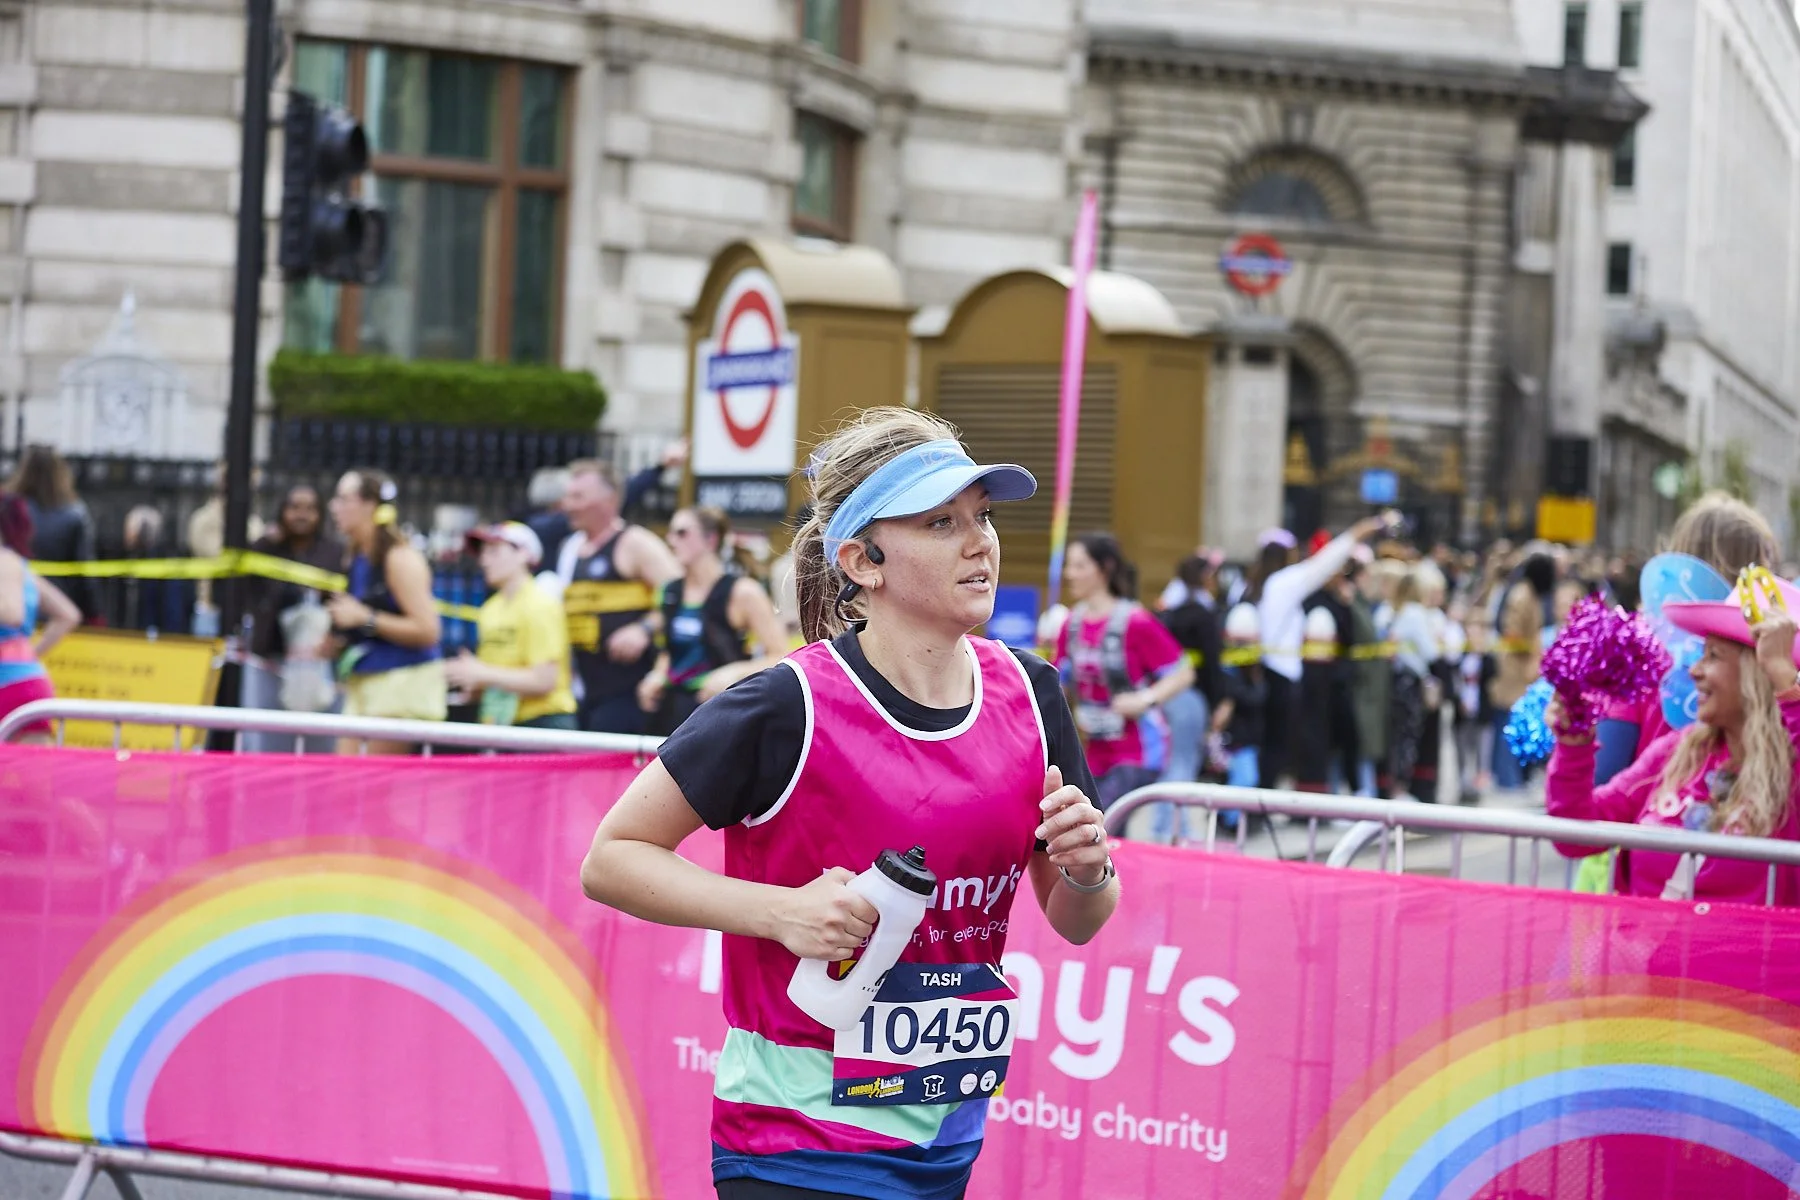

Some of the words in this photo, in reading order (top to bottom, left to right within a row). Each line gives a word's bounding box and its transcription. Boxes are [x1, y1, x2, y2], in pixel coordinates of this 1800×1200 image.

[929, 925, 948, 943] for
[954, 925, 990, 942] every
[920, 973, 961, 987] TASH
[859, 1004, 1010, 1056] 10450
[847, 1083, 874, 1096] LONDON
[1093, 1102, 1228, 1163] charity
